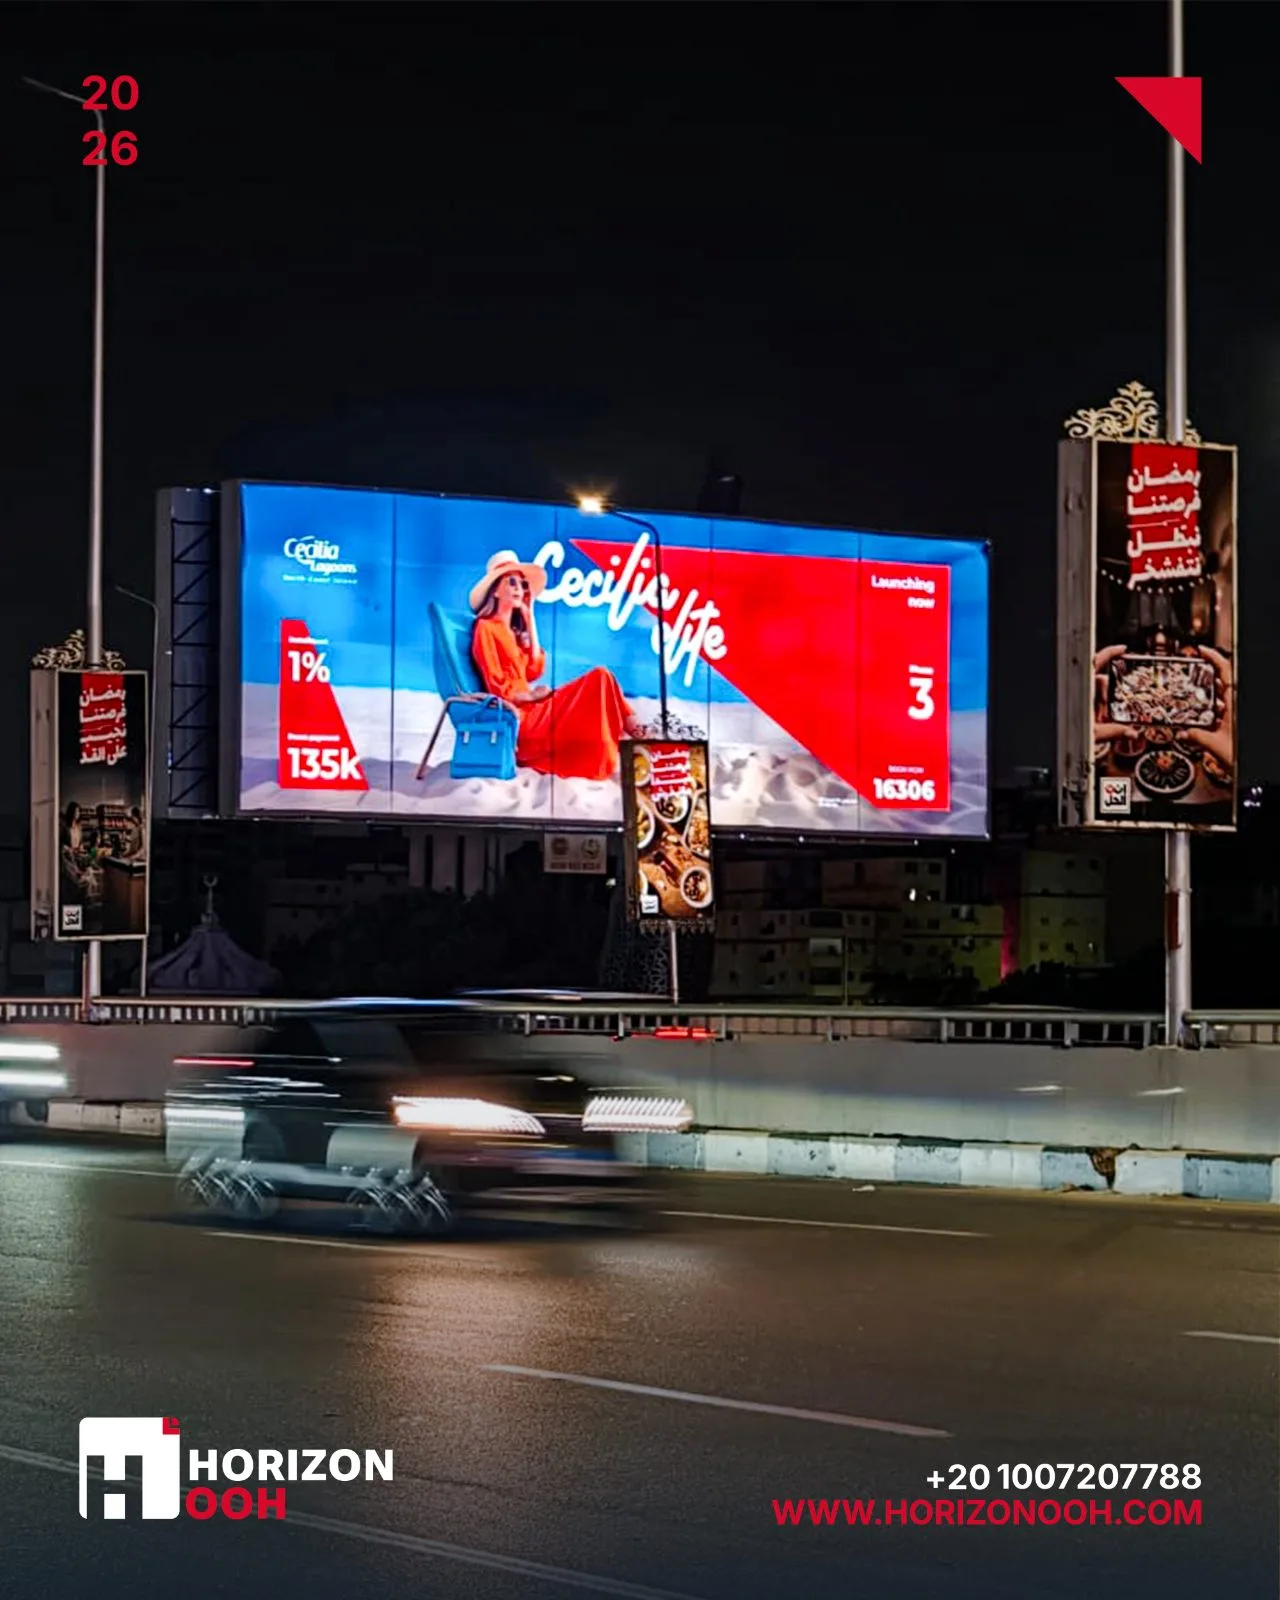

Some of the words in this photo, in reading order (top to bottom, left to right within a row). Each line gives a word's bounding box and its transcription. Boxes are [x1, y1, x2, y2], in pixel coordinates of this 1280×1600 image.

[1127, 462, 1201, 493] رمضان
[1127, 489, 1201, 519] فرصتنا
[871, 574, 935, 594] Launching
[287, 650, 331, 683] 1%
[907, 677, 935, 720] 3
[287, 747, 363, 780] 135k
[873, 777, 936, 802] 16306
